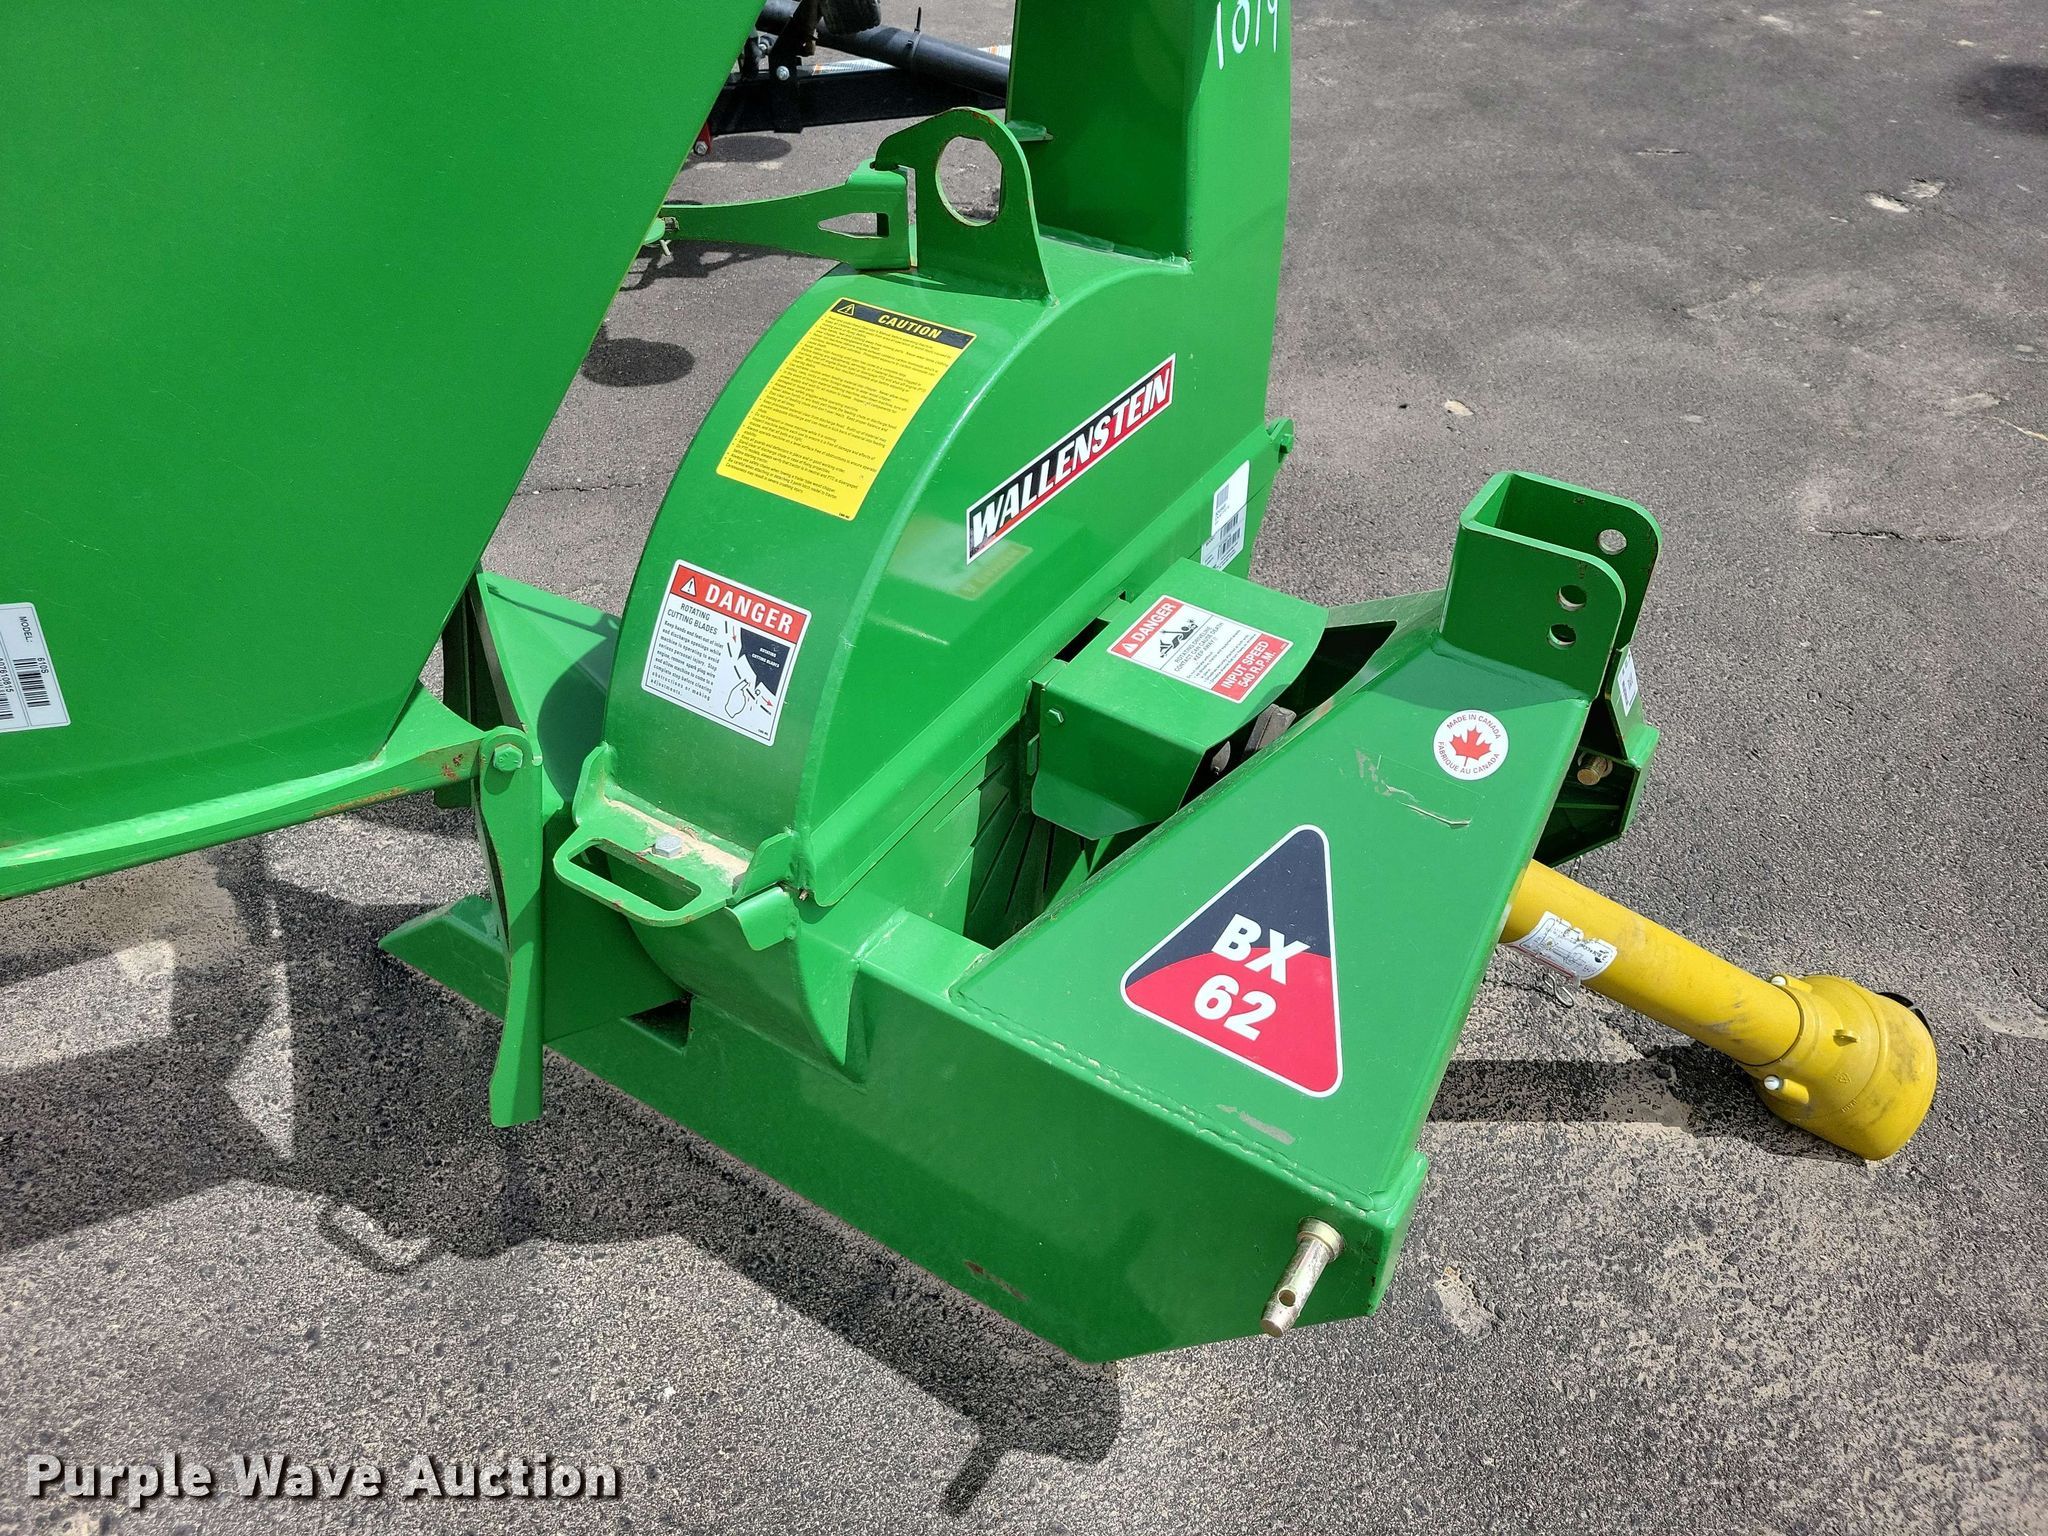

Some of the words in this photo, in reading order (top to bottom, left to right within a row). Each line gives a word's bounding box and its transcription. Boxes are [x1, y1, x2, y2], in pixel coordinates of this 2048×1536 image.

[878, 314, 942, 340] CAUTION
[971, 367, 1172, 546] WALLENSTEIN
[667, 608, 693, 624] CUTTING
[693, 619, 718, 635] BLADES
[680, 602, 710, 620] ROTATING
[704, 582, 794, 635] DANGER
[19, 616, 32, 642] MODEL:
[664, 620, 674, 628] Keep
[674, 624, 686, 633] hands
[1132, 602, 1177, 642] DANGER
[660, 635, 677, 645] machine
[682, 644, 702, 657] operating
[707, 655, 719, 663] avoid
[670, 631, 690, 644] discharge
[690, 640, 708, 651] openings
[709, 647, 721, 656] while
[1192, 649, 1205, 660] KEEP
[1201, 639, 1215, 650] AWAY
[37, 657, 49, 674] 610S
[662, 660, 673, 668] allow
[673, 664, 690, 675] machine
[670, 656, 684, 665] remove
[696, 666, 706, 674] plug
[673, 648, 692, 661] personal
[707, 663, 717, 671] Stop
[1173, 653, 1194, 671] CONTACT
[1190, 645, 1201, 654] CAN
[1219, 663, 1248, 688] INPUT
[1240, 640, 1270, 665] SPEED
[1236, 672, 1256, 687] 540
[1248, 649, 1277, 673] R.P.M.
[651, 671, 683, 688] obstructions
[691, 688, 710, 701] making
[652, 663, 671, 676] complete
[671, 672, 680, 680] stop
[680, 675, 694, 685] before
[694, 681, 712, 693] clearing
[1446, 714, 1468, 729] MADE
[1478, 716, 1501, 739] CANADA
[1438, 742, 1459, 771] FABRIQUE
[1473, 753, 1500, 774] CANADA
[1212, 914, 1310, 985] BX
[1194, 974, 1276, 1041] 62
